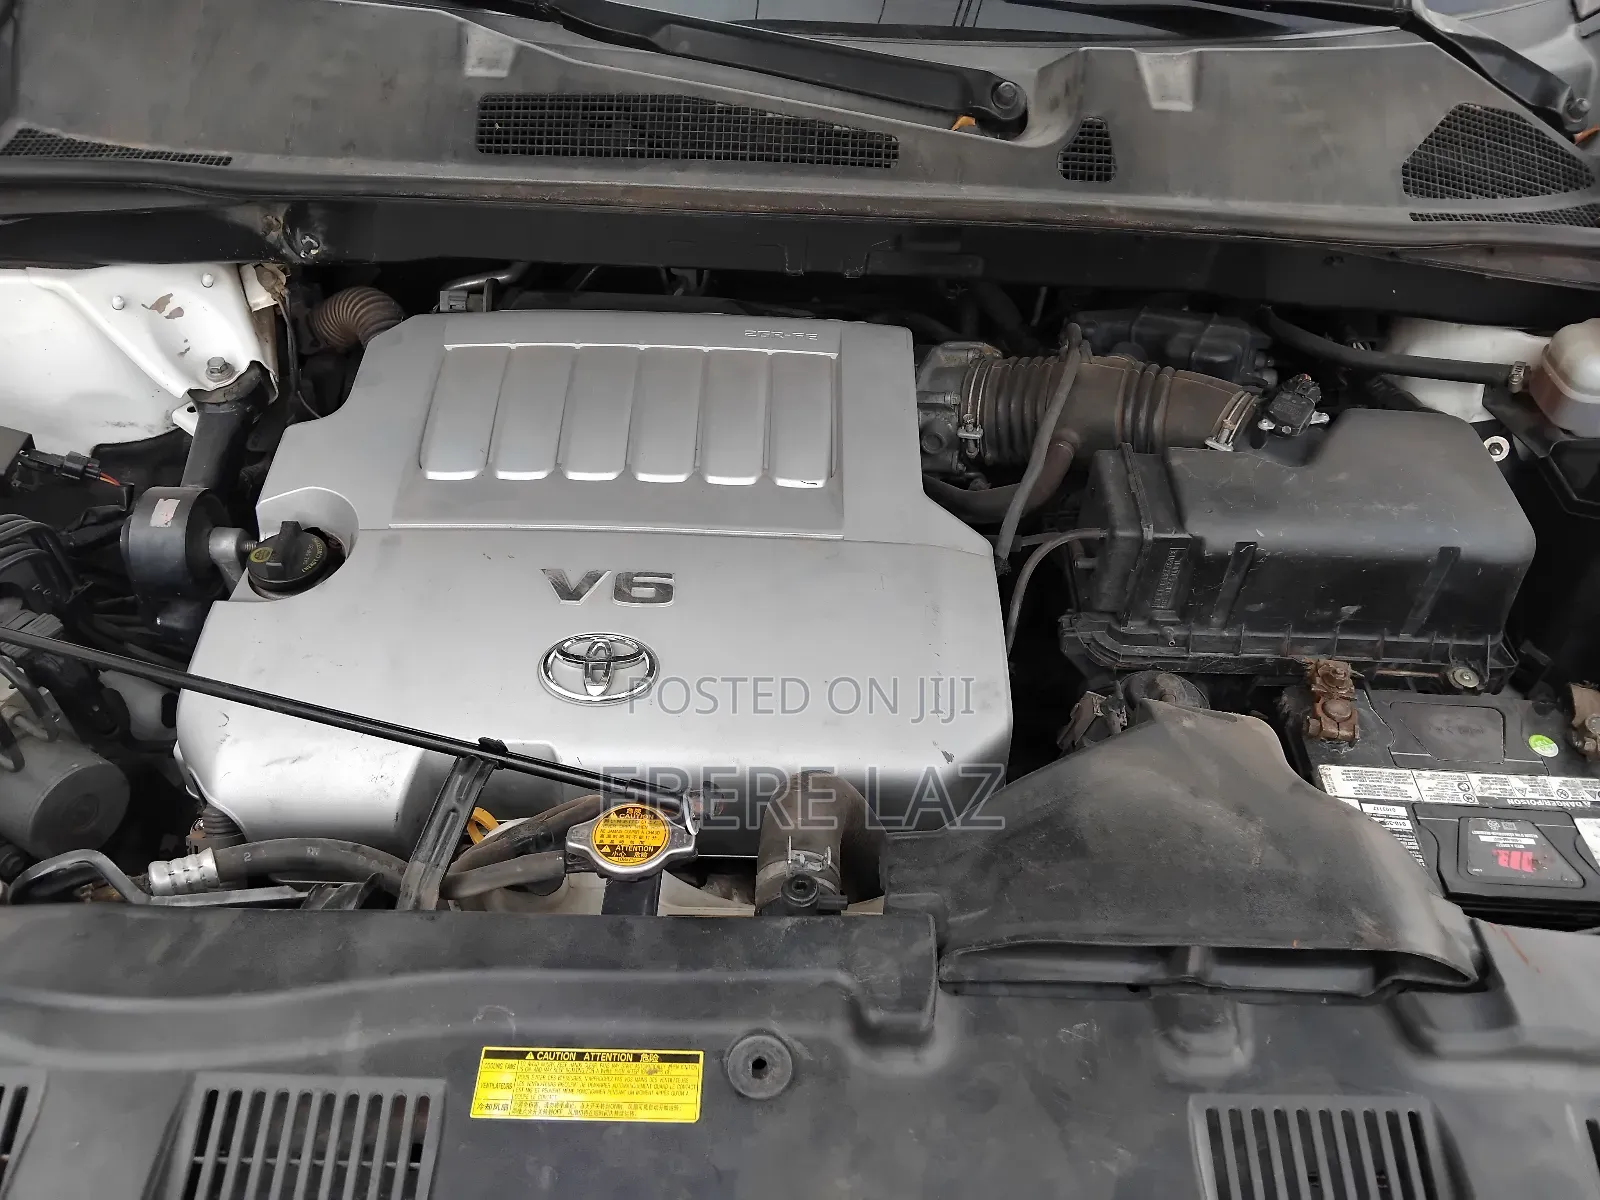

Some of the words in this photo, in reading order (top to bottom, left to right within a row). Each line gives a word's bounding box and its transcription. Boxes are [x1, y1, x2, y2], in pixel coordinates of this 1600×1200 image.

[540, 568, 675, 608] V6
[536, 1051, 576, 1061] CAUTION
[583, 1052, 633, 1062] ATTENTION
[640, 1053, 660, 1063] 危险
